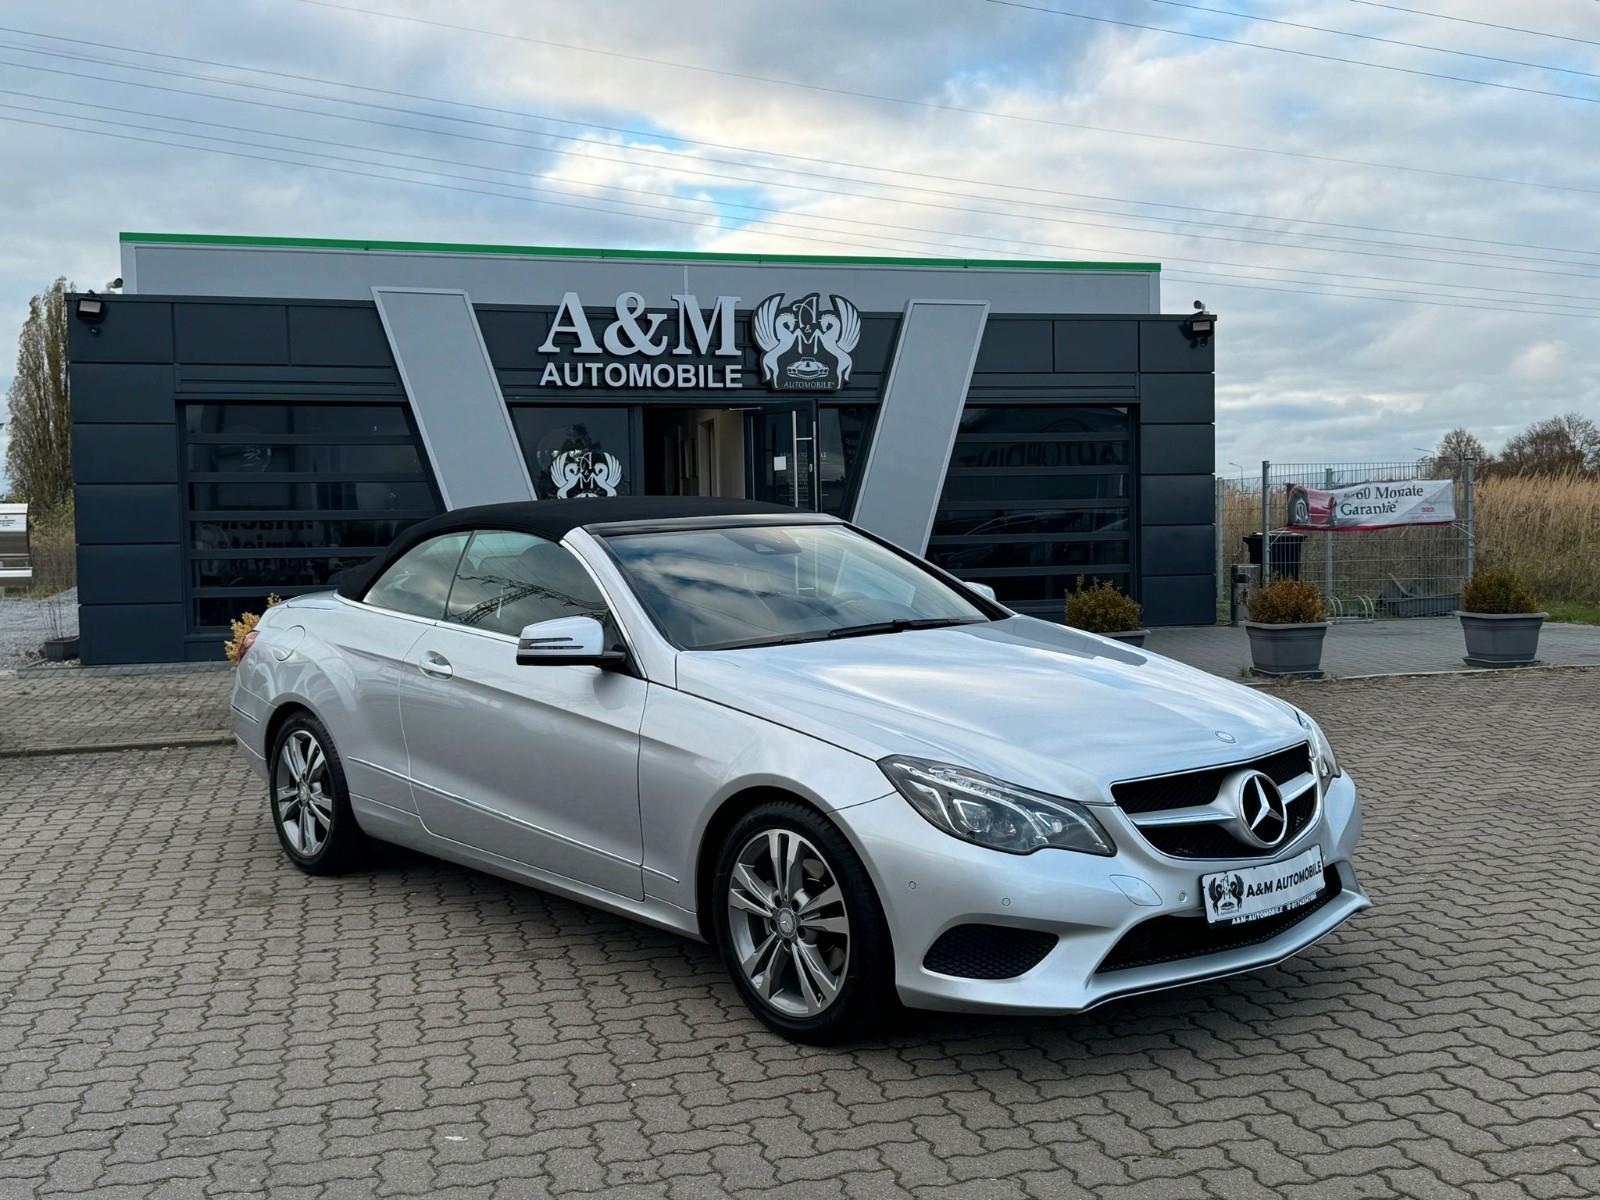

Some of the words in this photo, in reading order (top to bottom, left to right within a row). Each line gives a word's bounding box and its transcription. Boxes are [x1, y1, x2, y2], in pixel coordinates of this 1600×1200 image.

[538, 291, 742, 356] A&M
[539, 362, 743, 388] AUTOMOBILE
[1356, 487, 1371, 500] 60
[1375, 485, 1424, 499] Monate
[1246, 880, 1273, 898] A&M
[1276, 861, 1322, 888] AUTOMOBILE
